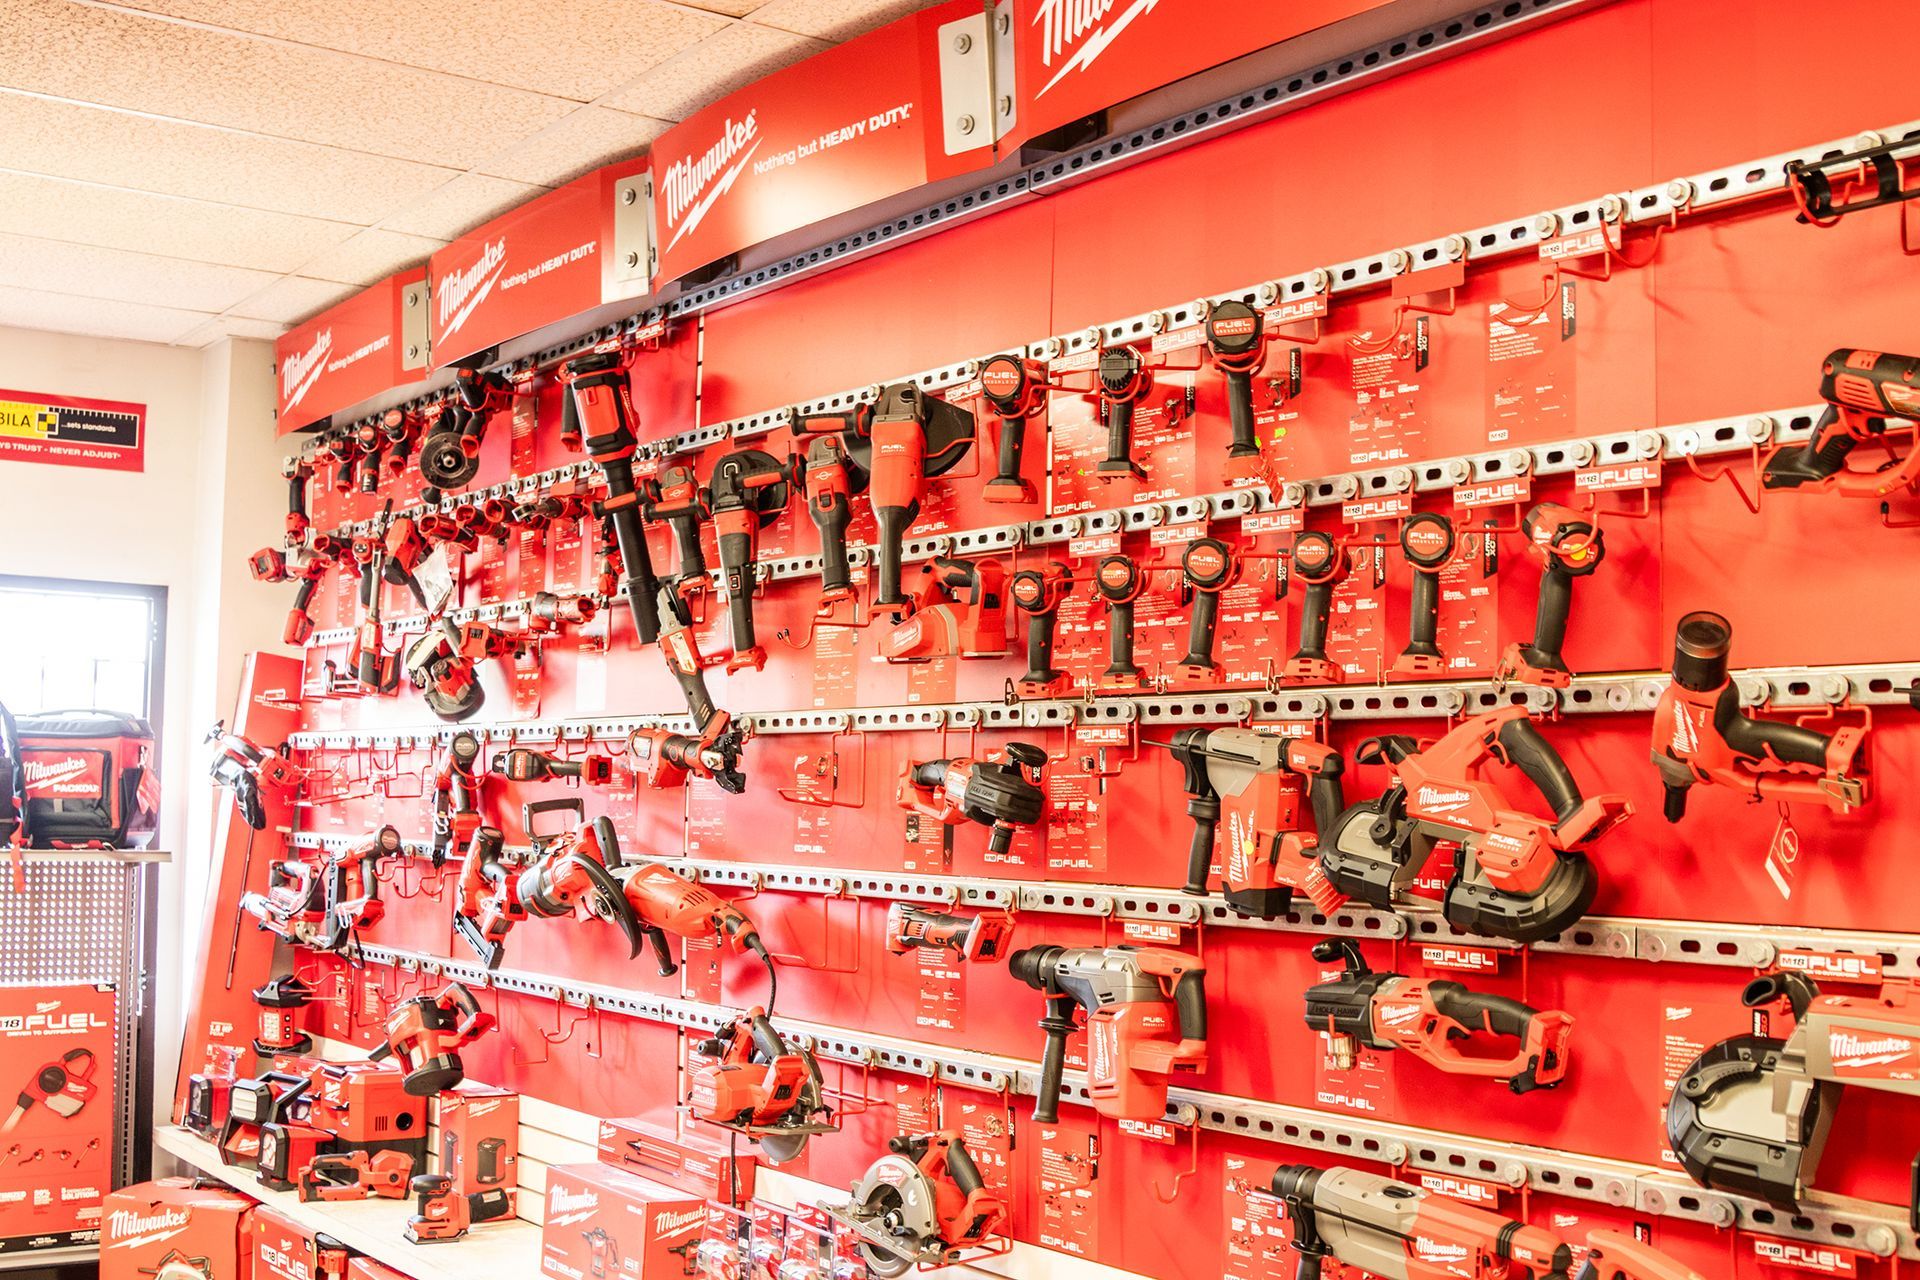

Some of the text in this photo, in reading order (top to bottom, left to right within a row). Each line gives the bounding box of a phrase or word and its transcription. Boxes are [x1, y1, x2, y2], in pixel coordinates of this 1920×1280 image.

[753, 151, 796, 175] Nothing
[798, 140, 817, 158] but
[819, 120, 866, 150] HEAVY
[661, 113, 757, 228] Milwaukee
[501, 271, 528, 291] Nothing
[528, 267, 541, 280] but
[541, 255, 570, 273] HEAVY
[437, 239, 506, 327] Milwaukee
[1282, 300, 1324, 316] FUEL
[1215, 320, 1251, 329] FUEL
[1166, 329, 1206, 343] FUEL
[281, 327, 333, 399] Milwaukee
[328, 355, 346, 373] Nothing
[356, 342, 374, 359] HEAVY
[984, 371, 1018, 380] FUEL
[82, 422, 116, 433] standards
[12, 442, 42, 452] TRUST
[50, 446, 80, 456] NEVER
[1369, 449, 1409, 461] FUEL
[1601, 467, 1657, 483] FUEL
[1148, 488, 1180, 499] FUEL
[1476, 483, 1526, 499] FUEL
[1066, 501, 1096, 513] FUEL
[1363, 500, 1408, 514] FUEL
[923, 522, 948, 532] FUEL
[1260, 514, 1301, 527] FUEL
[1167, 527, 1205, 538] FUEL
[1084, 537, 1119, 549] FUEL
[1191, 555, 1220, 563] FUEL
[1091, 729, 1126, 739] FUEL
[1270, 725, 1312, 736] FUEL
[1671, 700, 1690, 753] Milwaukee
[23, 757, 87, 782] Milwaukee
[1417, 786, 1470, 806] Milwaukee
[1247, 810, 1255, 841] FUEL
[1447, 815, 1473, 826] FUEL
[1229, 811, 1244, 883] Milwaukee
[1489, 833, 1523, 847] FUEL
[996, 855, 1025, 865] FUEL
[1063, 859, 1093, 868] FUEL
[1140, 925, 1177, 937] FUEL
[1444, 950, 1494, 965] FUEL
[1809, 956, 1878, 974] FUEL
[1380, 1005, 1420, 1020] Milwaukee
[26, 1013, 107, 1030] FUEL
[928, 1018, 954, 1028] FUEL
[1093, 1022, 1107, 1082] Milwaukee
[1830, 1033, 1911, 1059] Milwaukee
[1064, 1056, 1087, 1067] UEL
[1335, 1095, 1376, 1112] FUEL
[1135, 1122, 1172, 1136] FUEL
[1443, 1179, 1494, 1199] FUEL
[550, 1184, 599, 1215] Milwaukee
[108, 1208, 190, 1239] Milwaukee
[1053, 1237, 1084, 1253] FUEL
[1416, 1236, 1468, 1256] Milwaukee
[1784, 1245, 1852, 1270] FUEL
[277, 1252, 313, 1280] FUEL
[1447, 1266, 1471, 1278] FUEL
